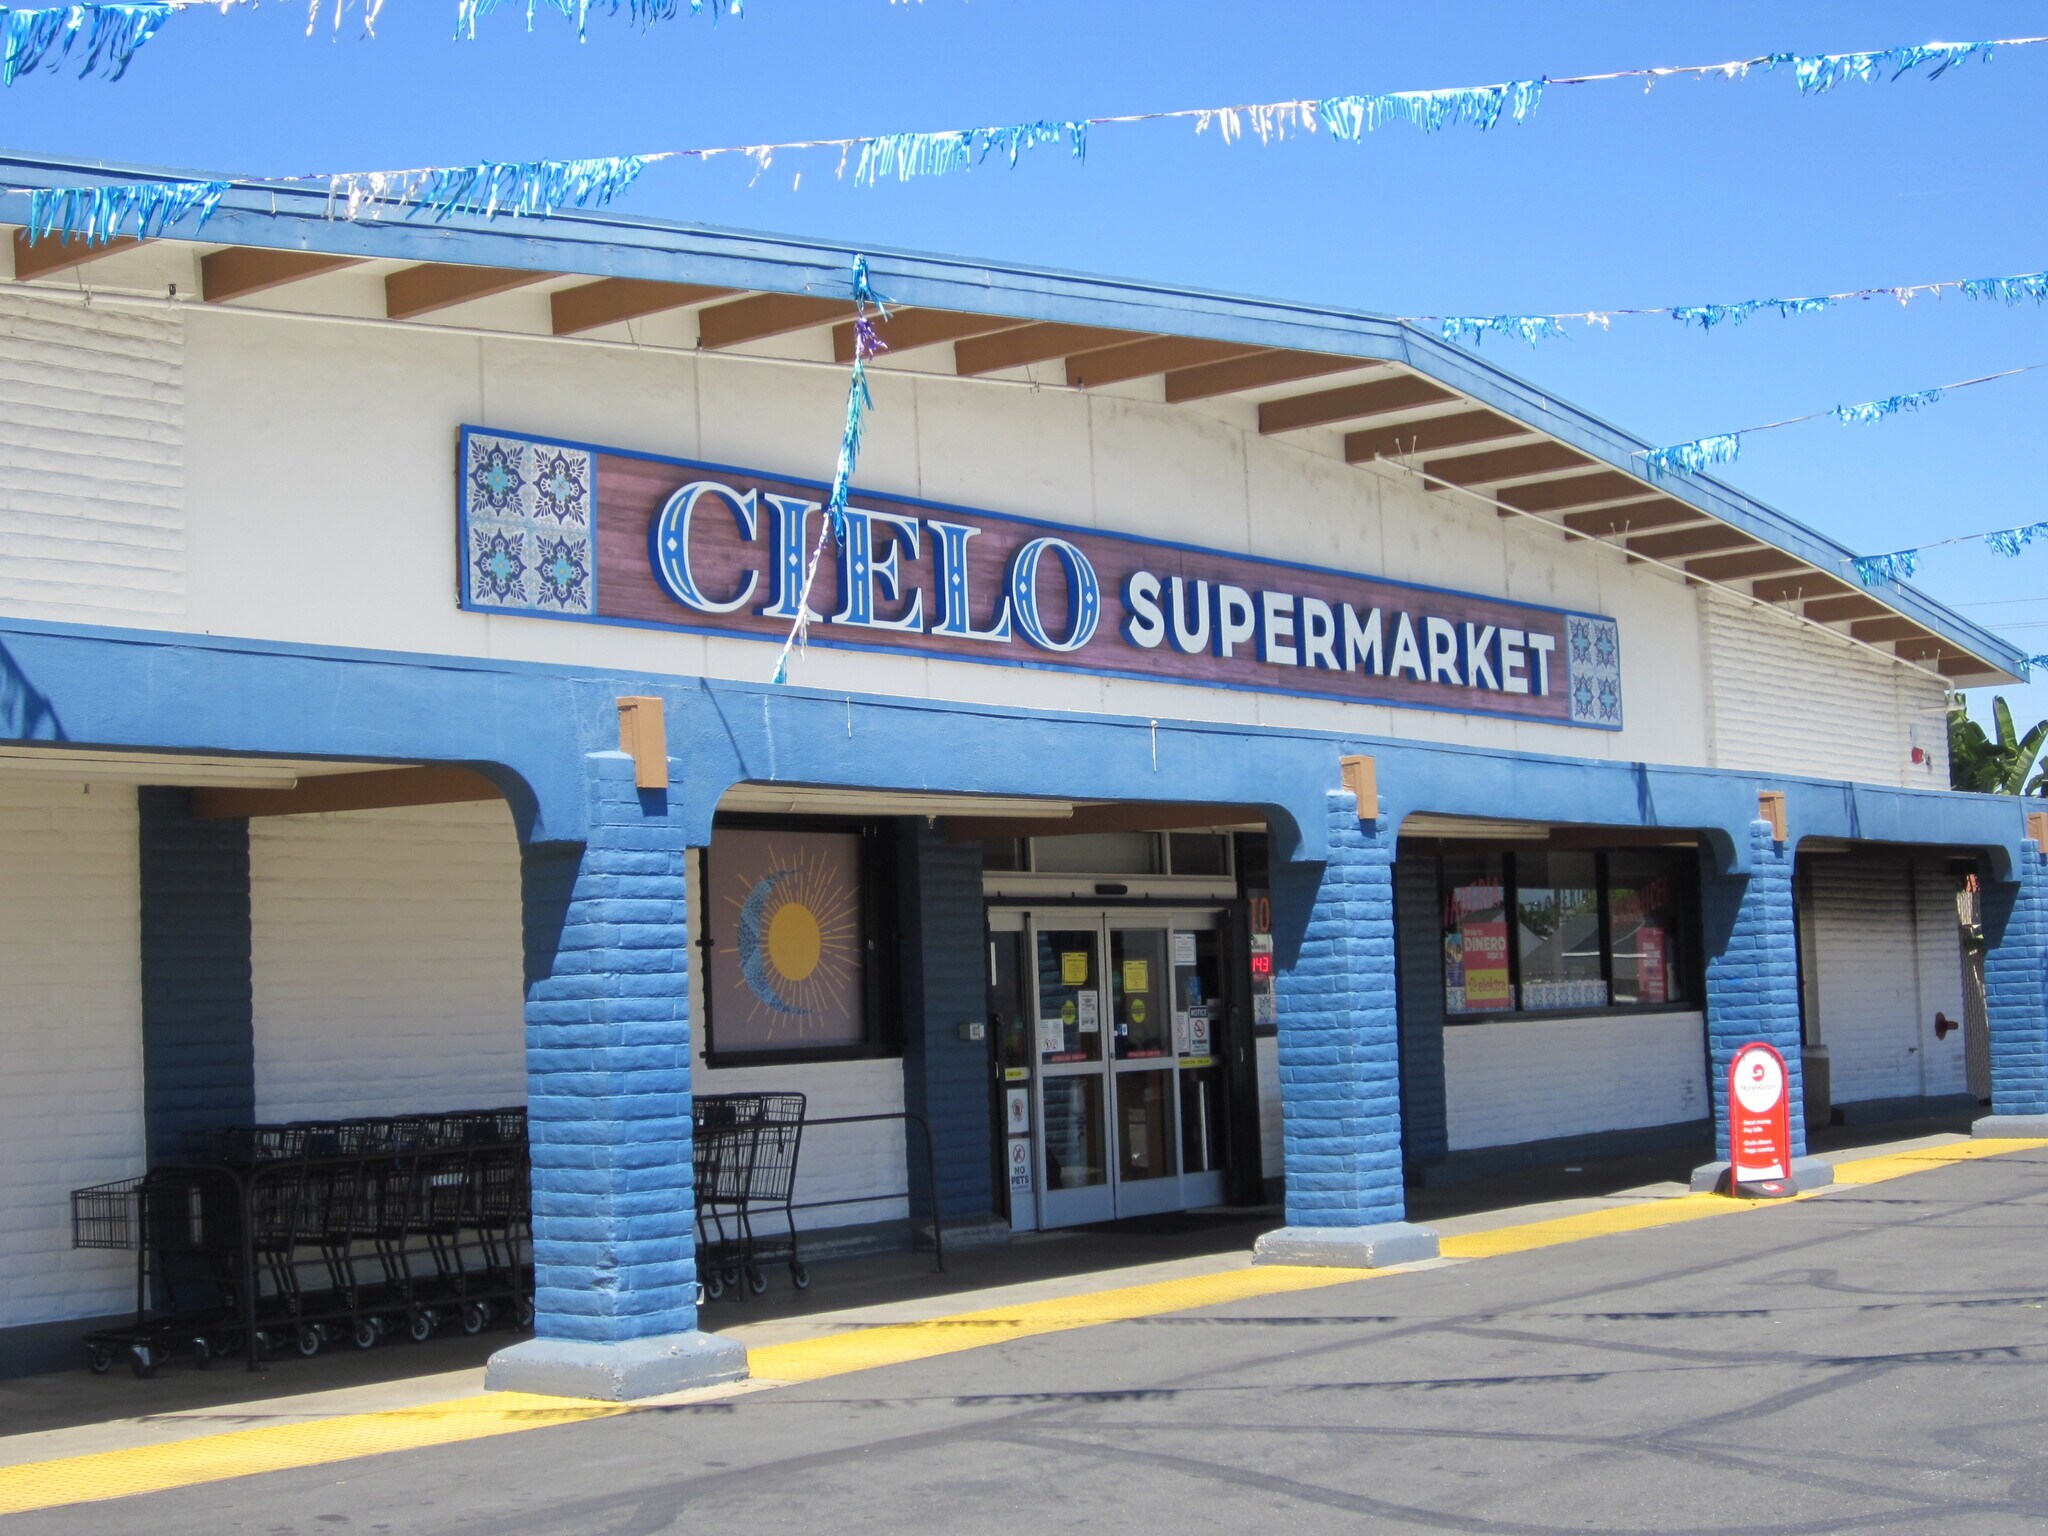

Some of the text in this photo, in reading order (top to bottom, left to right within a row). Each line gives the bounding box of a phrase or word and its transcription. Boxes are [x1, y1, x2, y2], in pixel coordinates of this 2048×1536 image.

[653, 480, 1556, 696] CIELO SUPERMARKET
[1465, 937, 1506, 951] DINERO
[1252, 957, 1269, 973] 143
[1478, 978, 1506, 992] elektra
[1190, 1008, 1208, 1017] NOTICE
[1741, 1084, 1776, 1092] MoneyGram
[1014, 1166, 1026, 1175] NO
[1011, 1175, 1029, 1185] PETS
